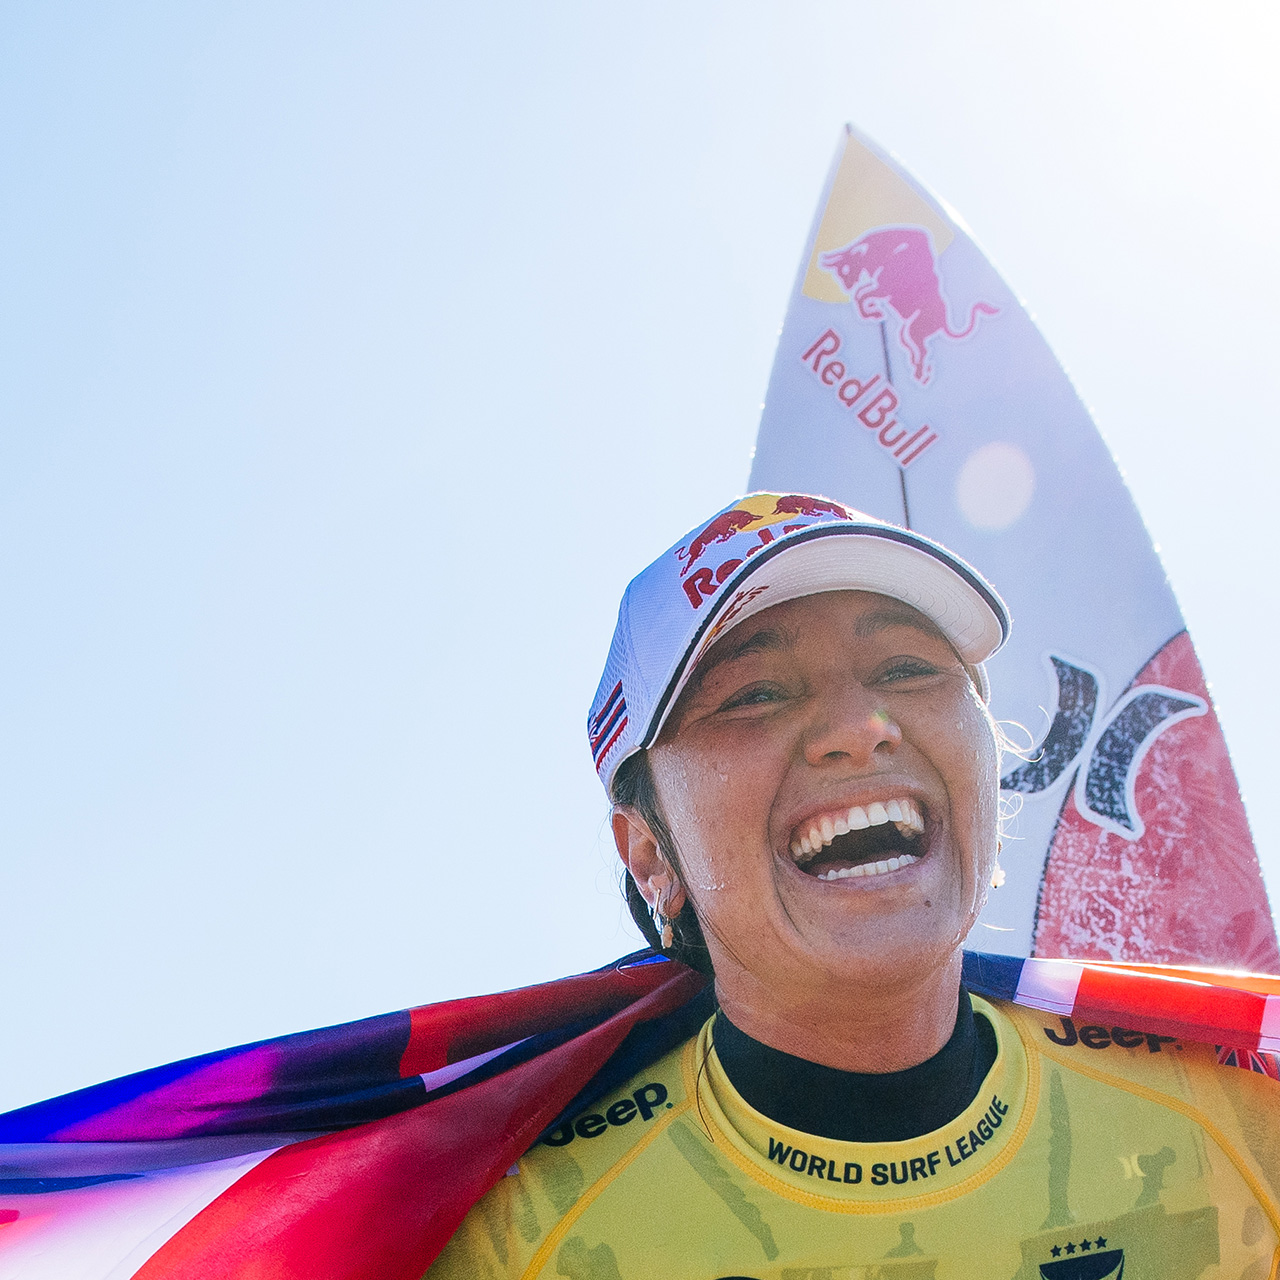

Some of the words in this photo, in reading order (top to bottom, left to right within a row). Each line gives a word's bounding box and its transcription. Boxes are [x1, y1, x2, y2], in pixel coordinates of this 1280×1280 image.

[767, 1136, 863, 1185] WORLD
[870, 1150, 942, 1186] SURF
[944, 1095, 1009, 1168] LEAGUE
